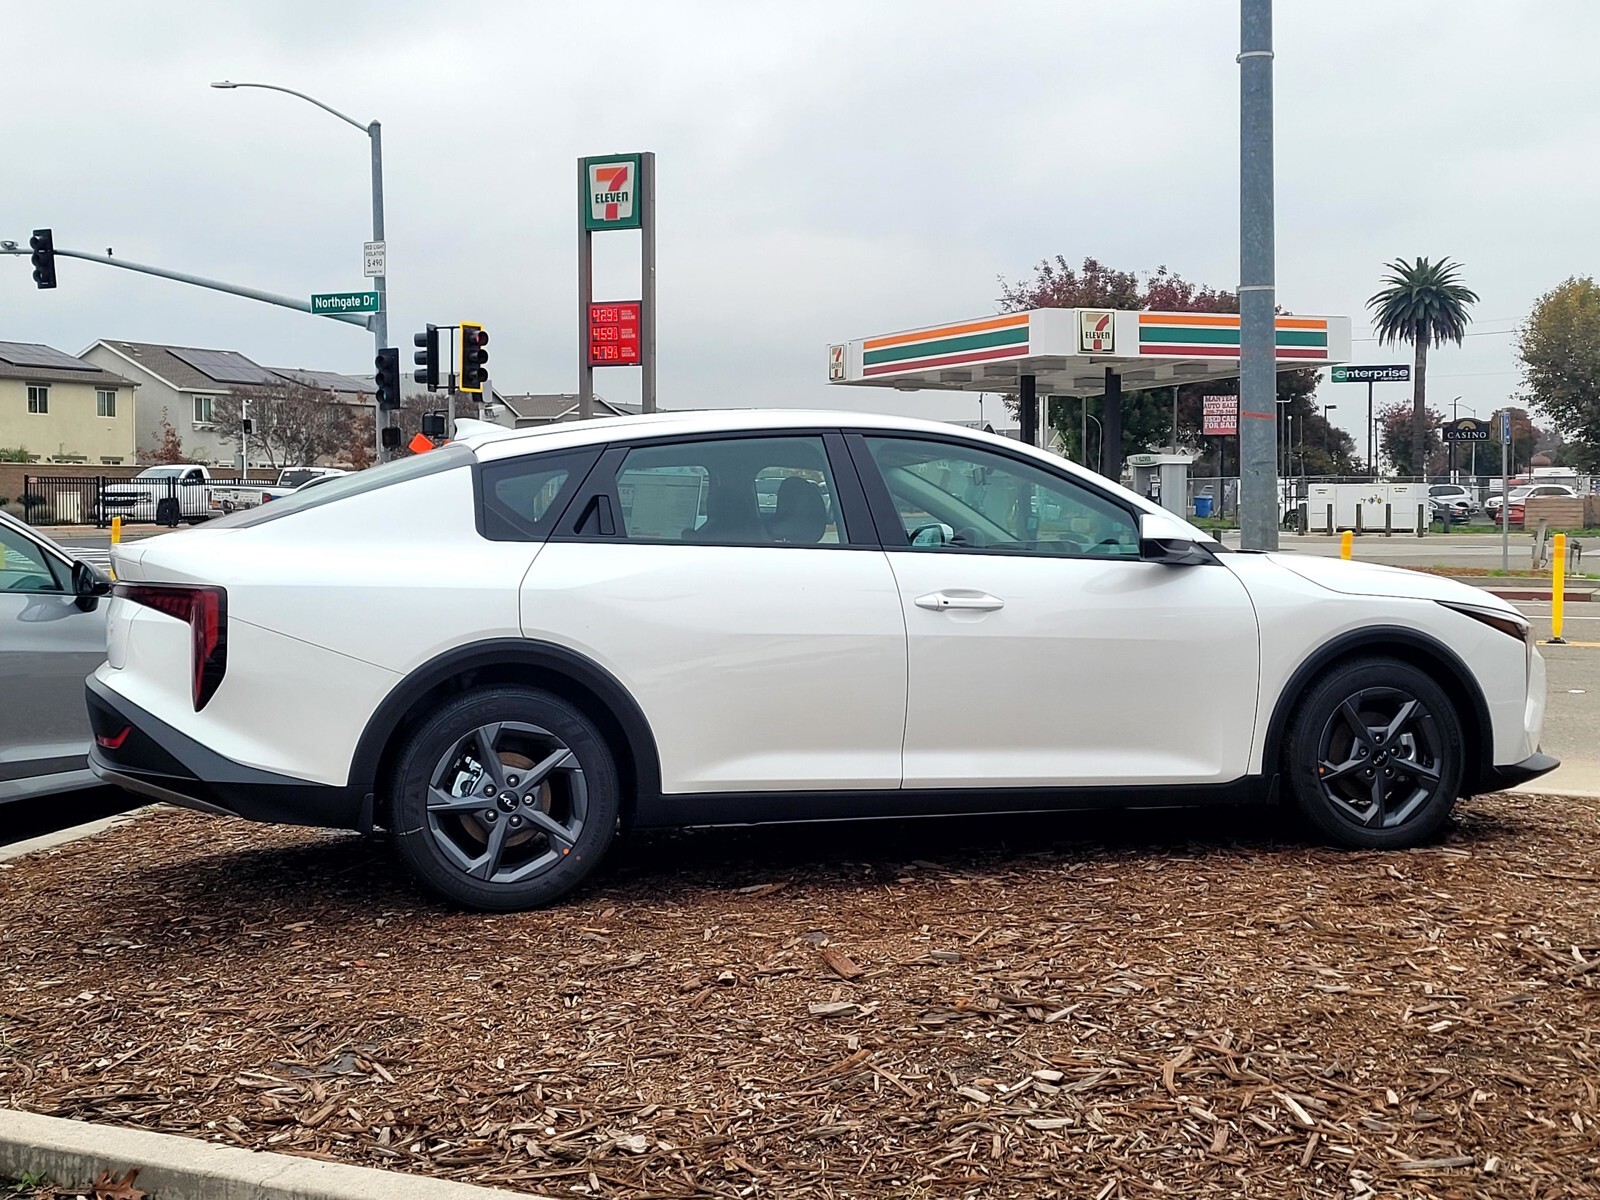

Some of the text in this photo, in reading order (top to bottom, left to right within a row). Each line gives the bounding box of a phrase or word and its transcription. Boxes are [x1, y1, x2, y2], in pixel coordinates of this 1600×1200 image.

[315, 295, 375, 310] Northgate Dr
[1332, 368, 1409, 380] enterprise
[1204, 415, 1221, 423] USED
[1447, 431, 1487, 439] CASINO
